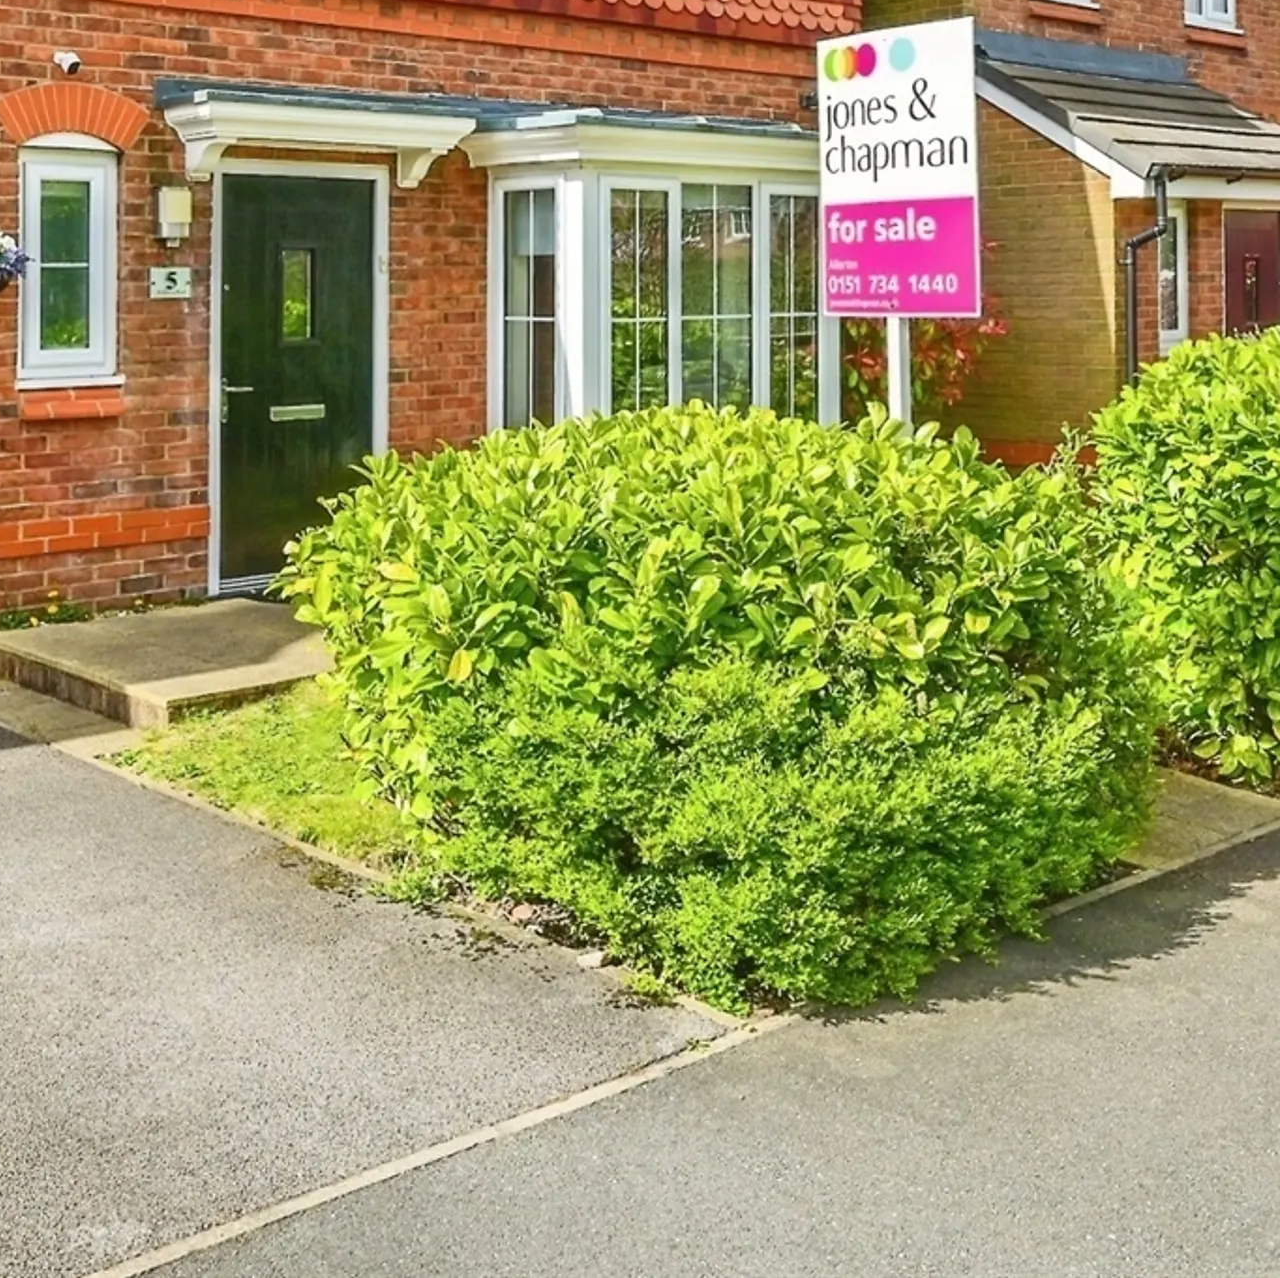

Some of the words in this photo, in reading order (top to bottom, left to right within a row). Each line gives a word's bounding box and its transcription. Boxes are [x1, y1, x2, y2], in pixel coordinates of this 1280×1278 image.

[825, 95, 898, 142] jones
[908, 77, 937, 122] &
[825, 135, 968, 183] chapman
[827, 211, 867, 245] for
[874, 207, 937, 243] sale
[166, 271, 178, 291] 5
[827, 274, 861, 295] 0151
[868, 274, 900, 294] 734
[908, 273, 958, 294] 1440
